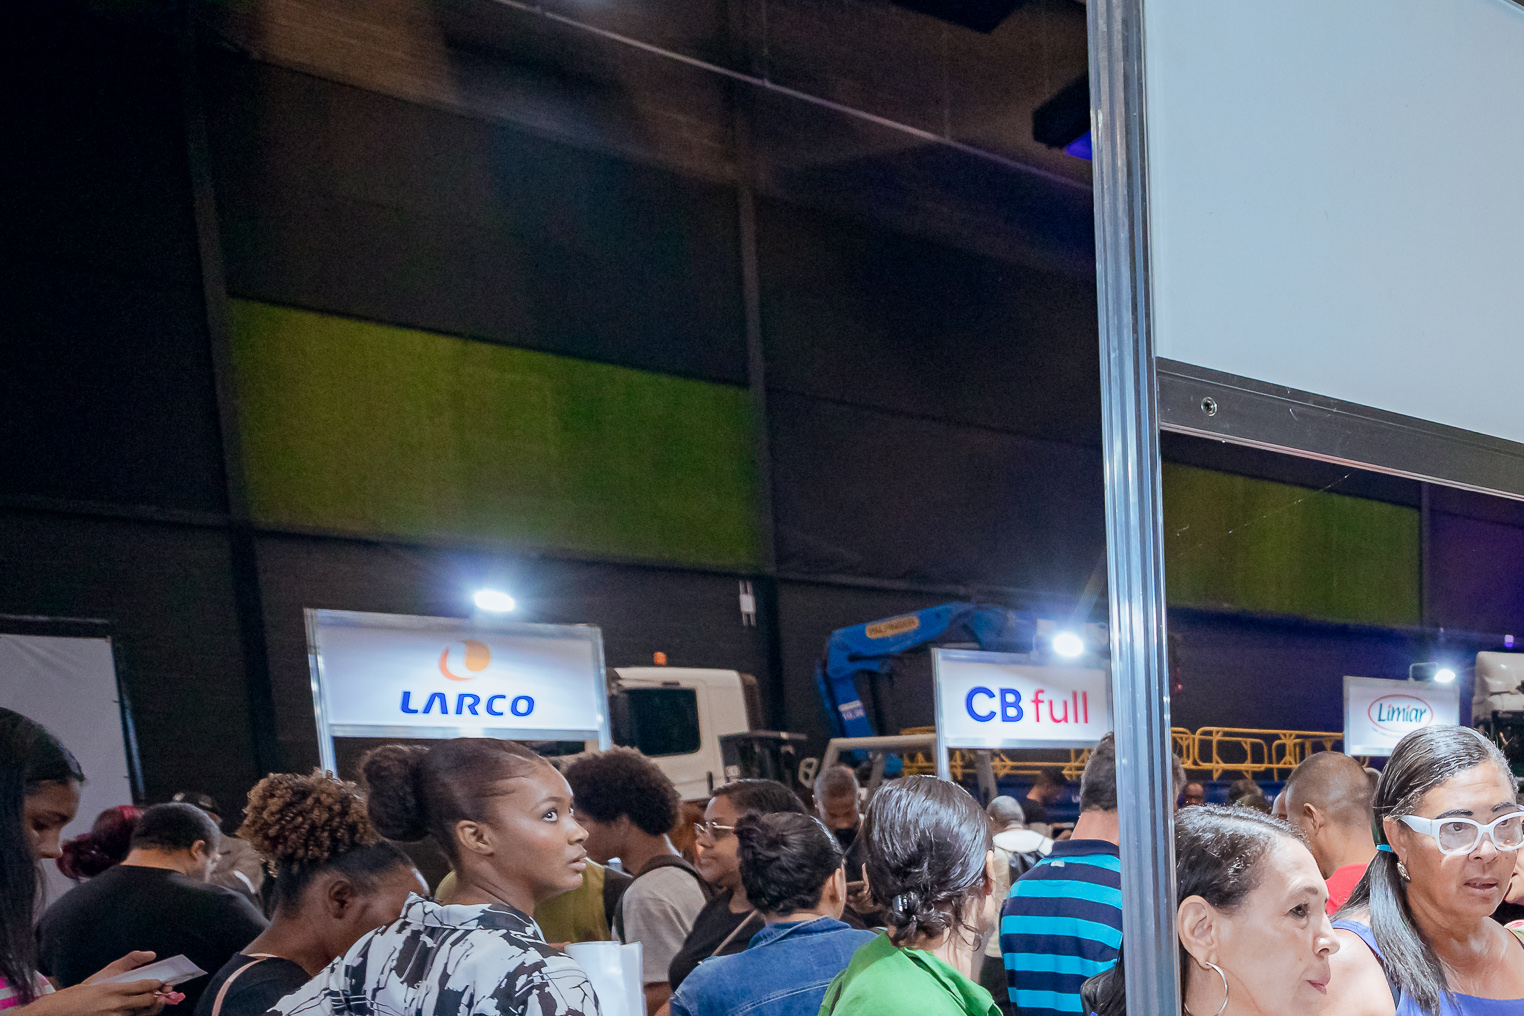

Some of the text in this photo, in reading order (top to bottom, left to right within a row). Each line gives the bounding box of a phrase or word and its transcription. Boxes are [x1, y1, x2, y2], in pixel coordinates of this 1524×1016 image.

[400, 690, 535, 717] LARCO
[965, 686, 1089, 724] CB full
[1377, 702, 1427, 723] Limiar
